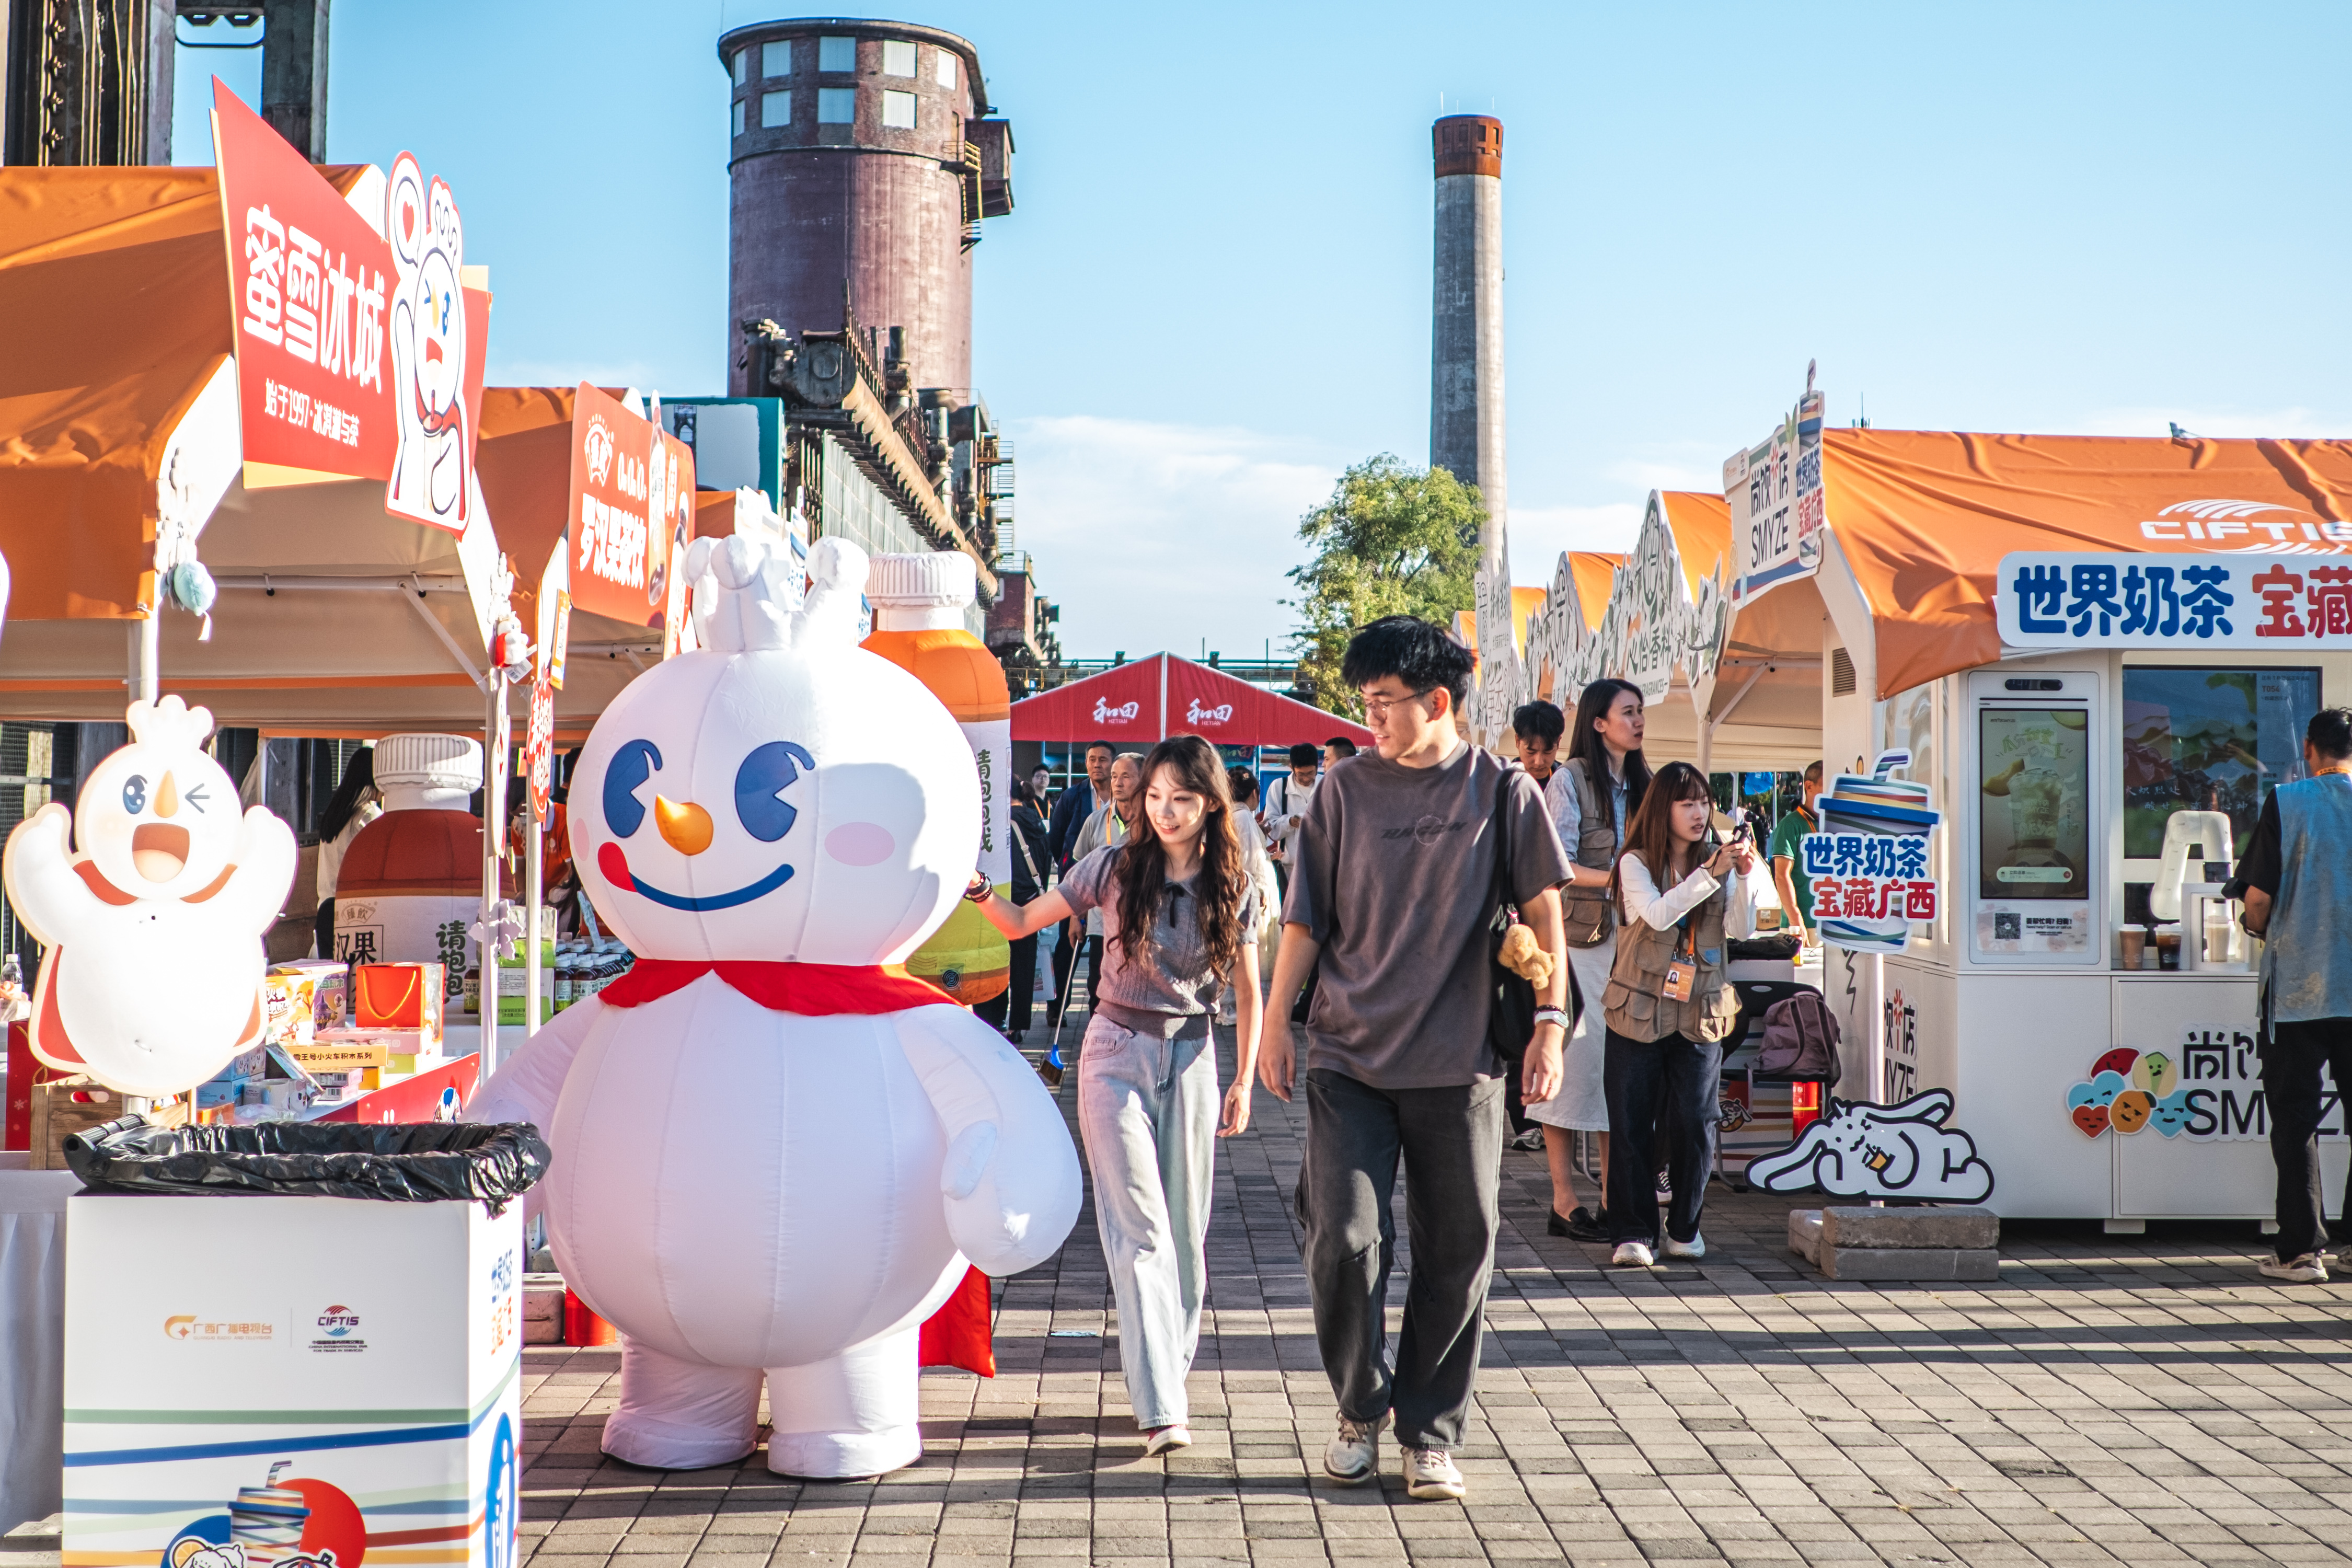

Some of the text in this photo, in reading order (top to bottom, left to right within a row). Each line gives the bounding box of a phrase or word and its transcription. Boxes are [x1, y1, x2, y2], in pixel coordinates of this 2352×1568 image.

[244, 203, 385, 394] 蜜雪冰城
[1796, 446, 1820, 498] 世界奶茶
[1798, 487, 1823, 539] 宝藏广西
[2140, 521, 2352, 540] CIFTIS
[1751, 505, 1789, 569] SMYZE
[2014, 564, 2234, 638] 世界奶茶
[1093, 696, 1139, 724] 和田
[1186, 697, 1232, 725] 和田
[1804, 836, 1927, 879] 世界奶茶
[1813, 878, 1936, 919] 宝藏广西
[293, 1052, 373, 1061] 雪王号小火车积木系列
[193, 1323, 272, 1334] 广西广播电视台
[317, 1316, 360, 1327] CIFTIS
